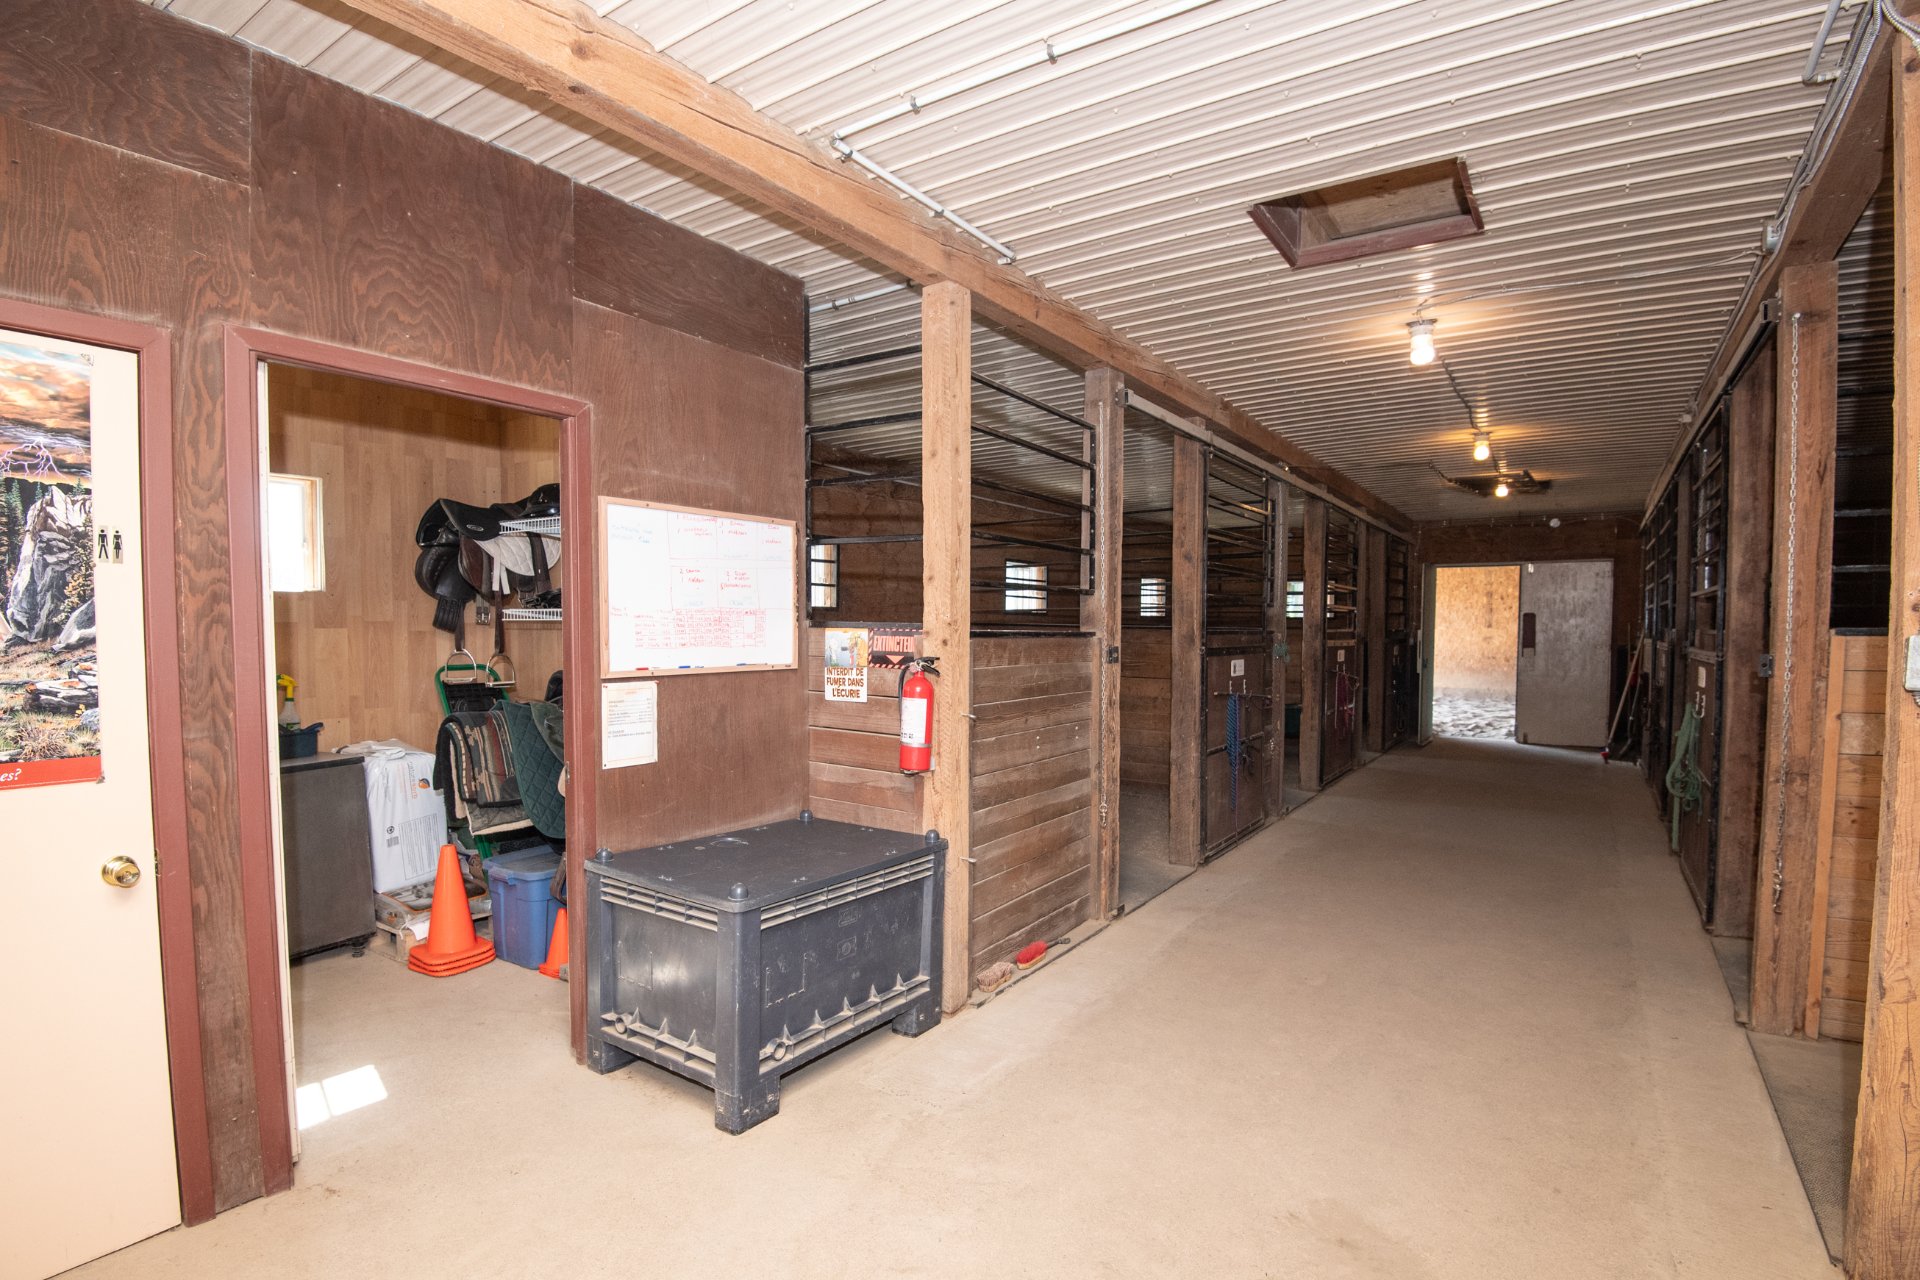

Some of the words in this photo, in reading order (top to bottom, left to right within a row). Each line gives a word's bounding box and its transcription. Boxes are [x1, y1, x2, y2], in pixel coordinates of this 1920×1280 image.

[873, 636, 914, 652] EXTINCTEU
[826, 667, 854, 676] INTERDIT
[856, 667, 864, 676] DE
[826, 677, 846, 686] FUMER
[847, 678, 864, 687] DANS
